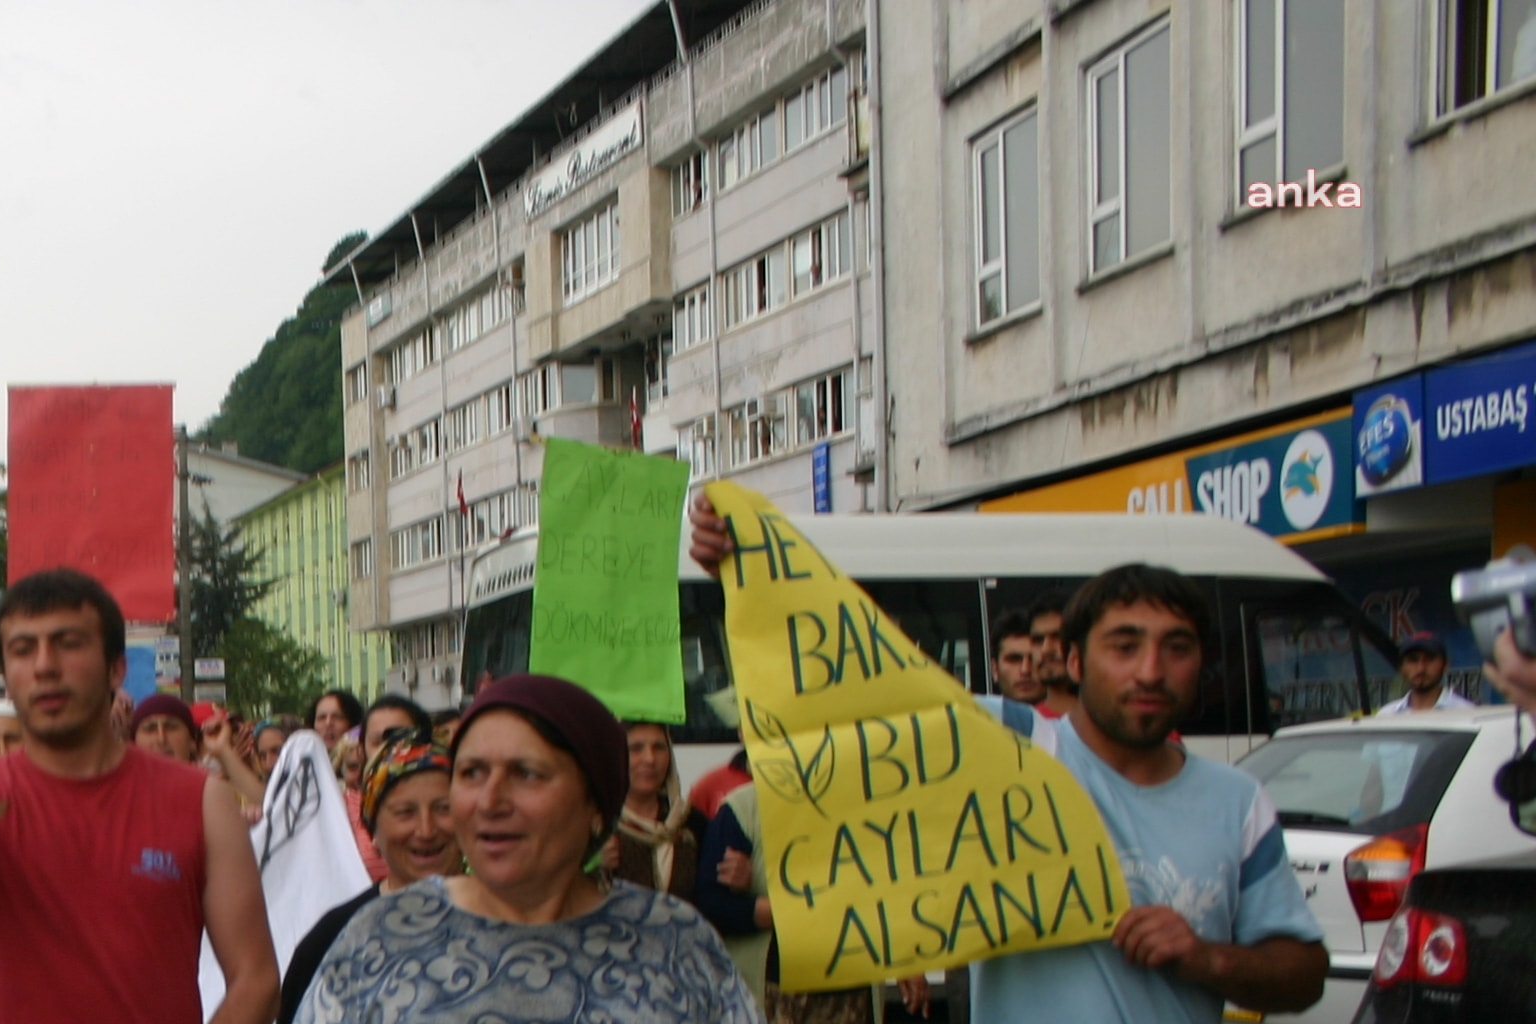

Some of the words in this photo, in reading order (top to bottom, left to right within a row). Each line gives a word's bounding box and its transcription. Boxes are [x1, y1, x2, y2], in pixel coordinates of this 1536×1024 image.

[1436, 384, 1528, 441] USTABAŞ
[1197, 457, 1270, 524] SHOP
[541, 530, 656, 582] DEREYE
[855, 703, 961, 803] BU
[779, 781, 1069, 908] ÇAYLARI
[825, 844, 1115, 977] ALSANA!
